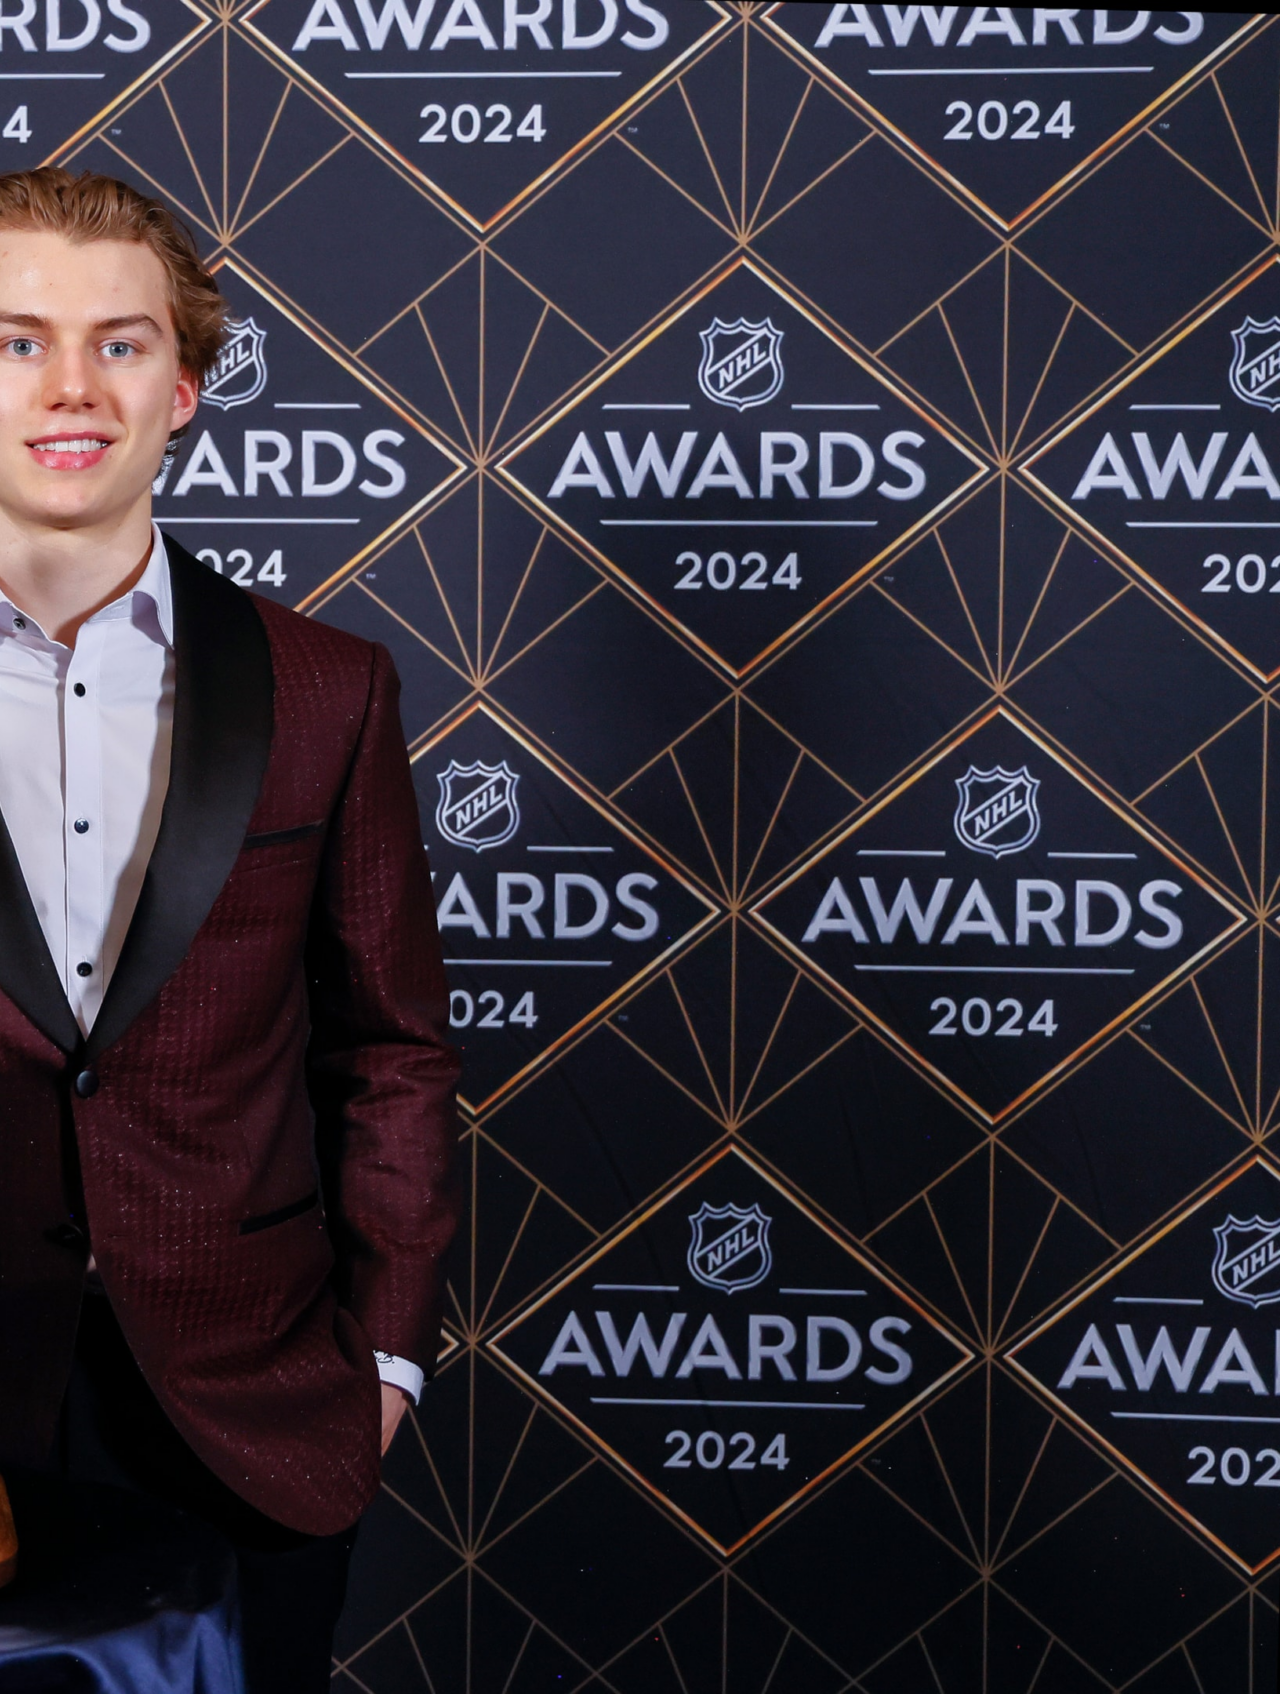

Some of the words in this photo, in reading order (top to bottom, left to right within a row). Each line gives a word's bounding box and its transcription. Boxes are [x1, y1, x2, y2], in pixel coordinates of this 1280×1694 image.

[292, 0, 671, 53] AWARDS
[419, 104, 548, 144] 2024
[944, 101, 1076, 141] 2024
[718, 342, 767, 390] NHL
[153, 429, 408, 500] ARDS
[548, 431, 927, 502] AWARDS
[1072, 433, 1280, 501] AWA
[675, 553, 803, 591] 2024
[1202, 555, 1280, 594] 20
[455, 784, 503, 831] NHL
[974, 789, 1023, 837] NHL
[430, 872, 659, 942] ARDS
[803, 878, 1184, 950] AWARDS
[450, 991, 539, 1029] 024
[930, 998, 1059, 1037] 2024
[707, 1226, 755, 1273] NHL
[1232, 1239, 1280, 1287] NHL
[540, 1312, 912, 1385] AWARDS
[1059, 1325, 1280, 1396] AWA
[665, 1432, 790, 1470] 2024
[1188, 1447, 1280, 1487] 202
